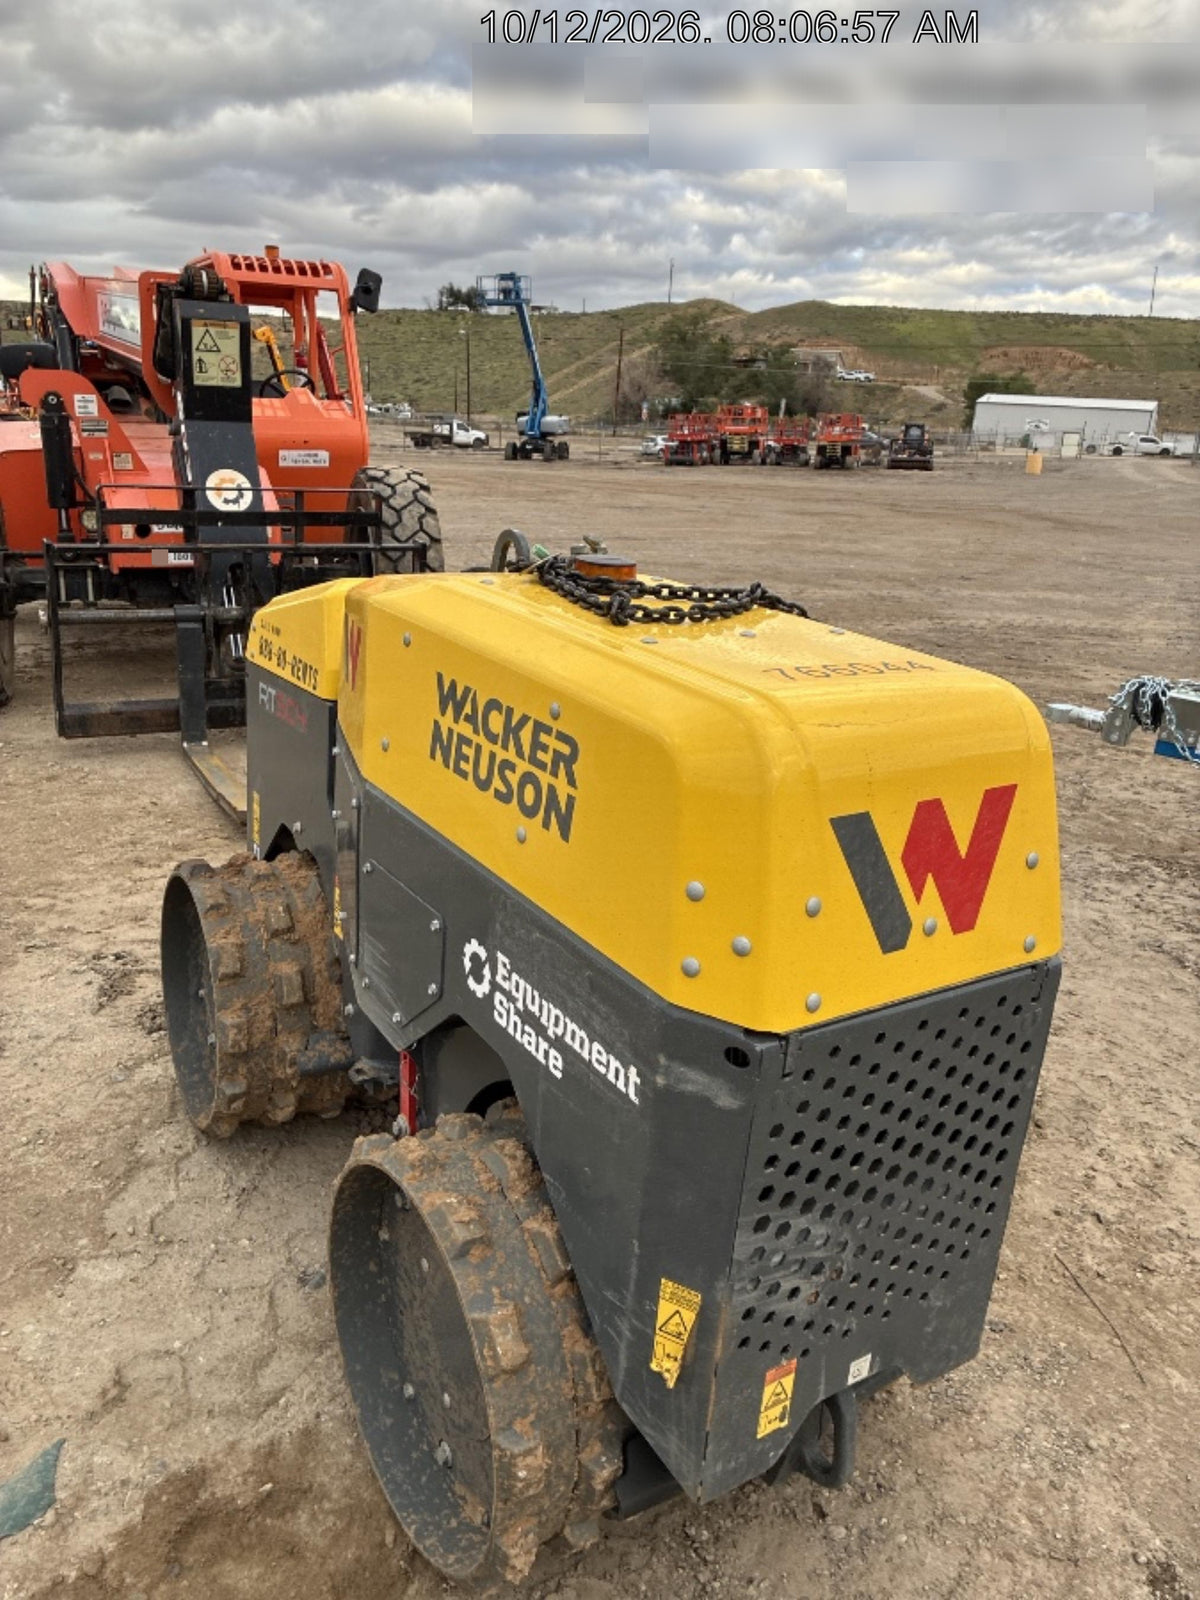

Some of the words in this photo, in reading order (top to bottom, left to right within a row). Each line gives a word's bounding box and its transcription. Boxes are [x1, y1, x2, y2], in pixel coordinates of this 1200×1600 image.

[430, 719, 577, 843] NEUSON
[436, 671, 580, 790] WACKER
[493, 991, 563, 1080] Share
[495, 950, 641, 1105] Equipment
